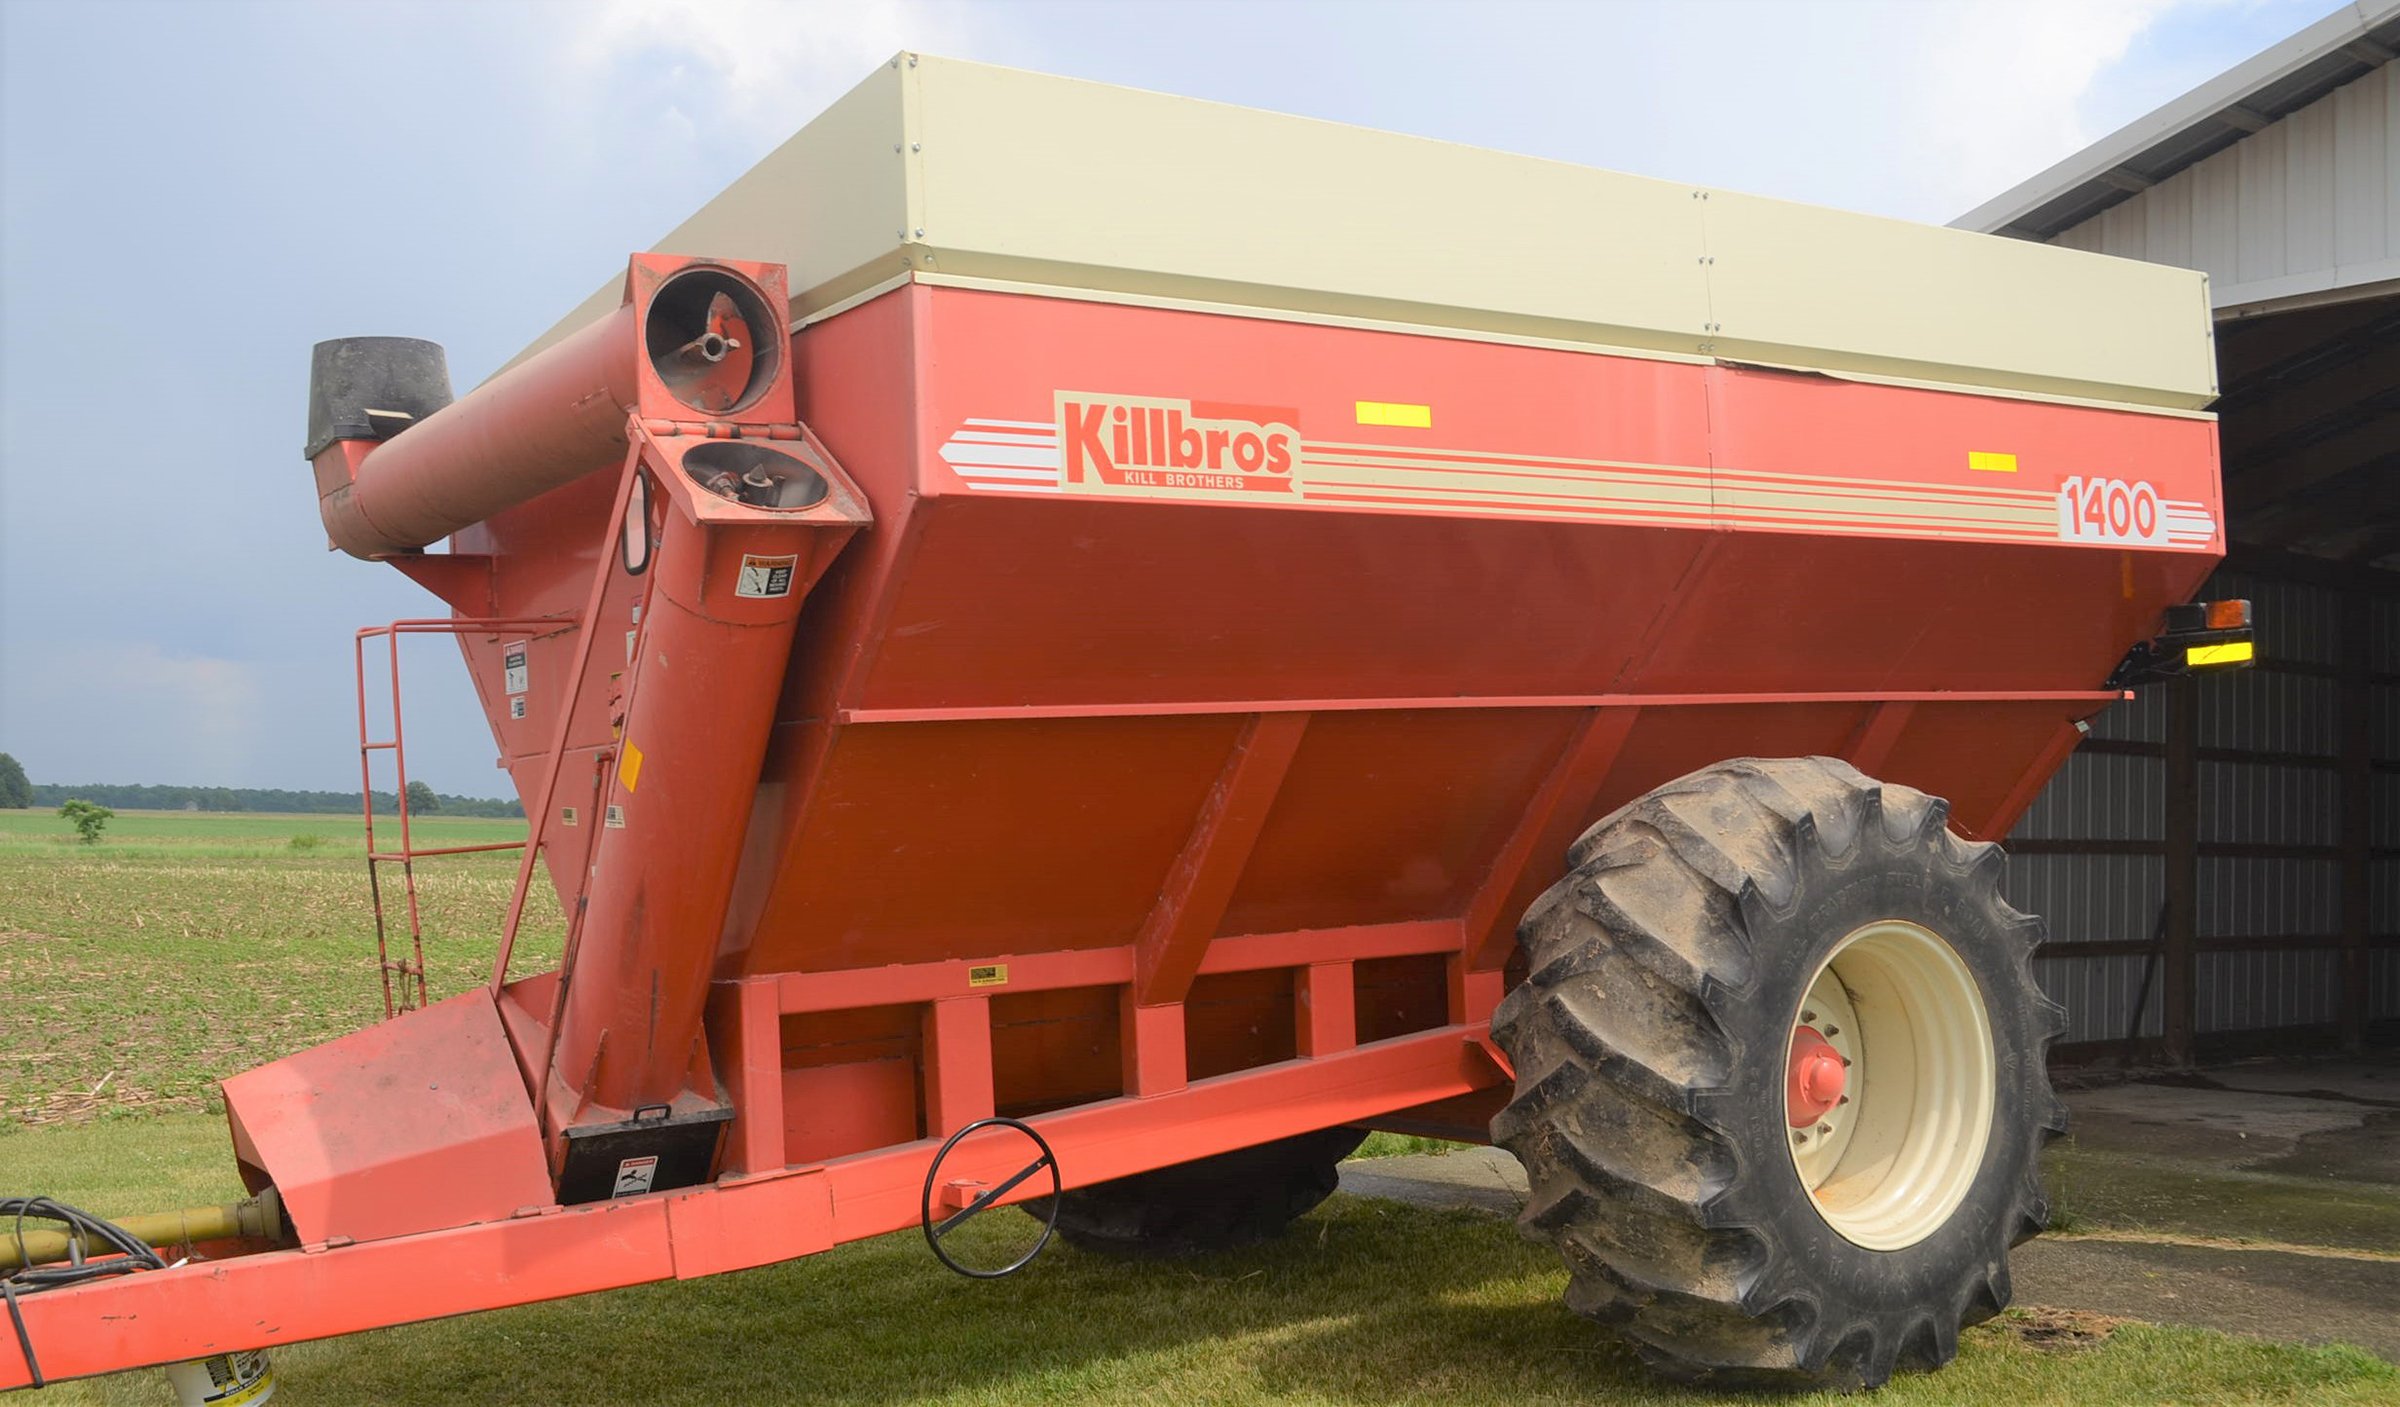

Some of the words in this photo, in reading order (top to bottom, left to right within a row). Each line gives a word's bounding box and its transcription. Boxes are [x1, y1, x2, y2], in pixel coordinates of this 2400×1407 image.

[1064, 402, 1292, 484] Killbros
[1125, 471, 1157, 485] KILL
[1166, 473, 1244, 489] BROTHERS
[2067, 484, 2157, 539] 1400
